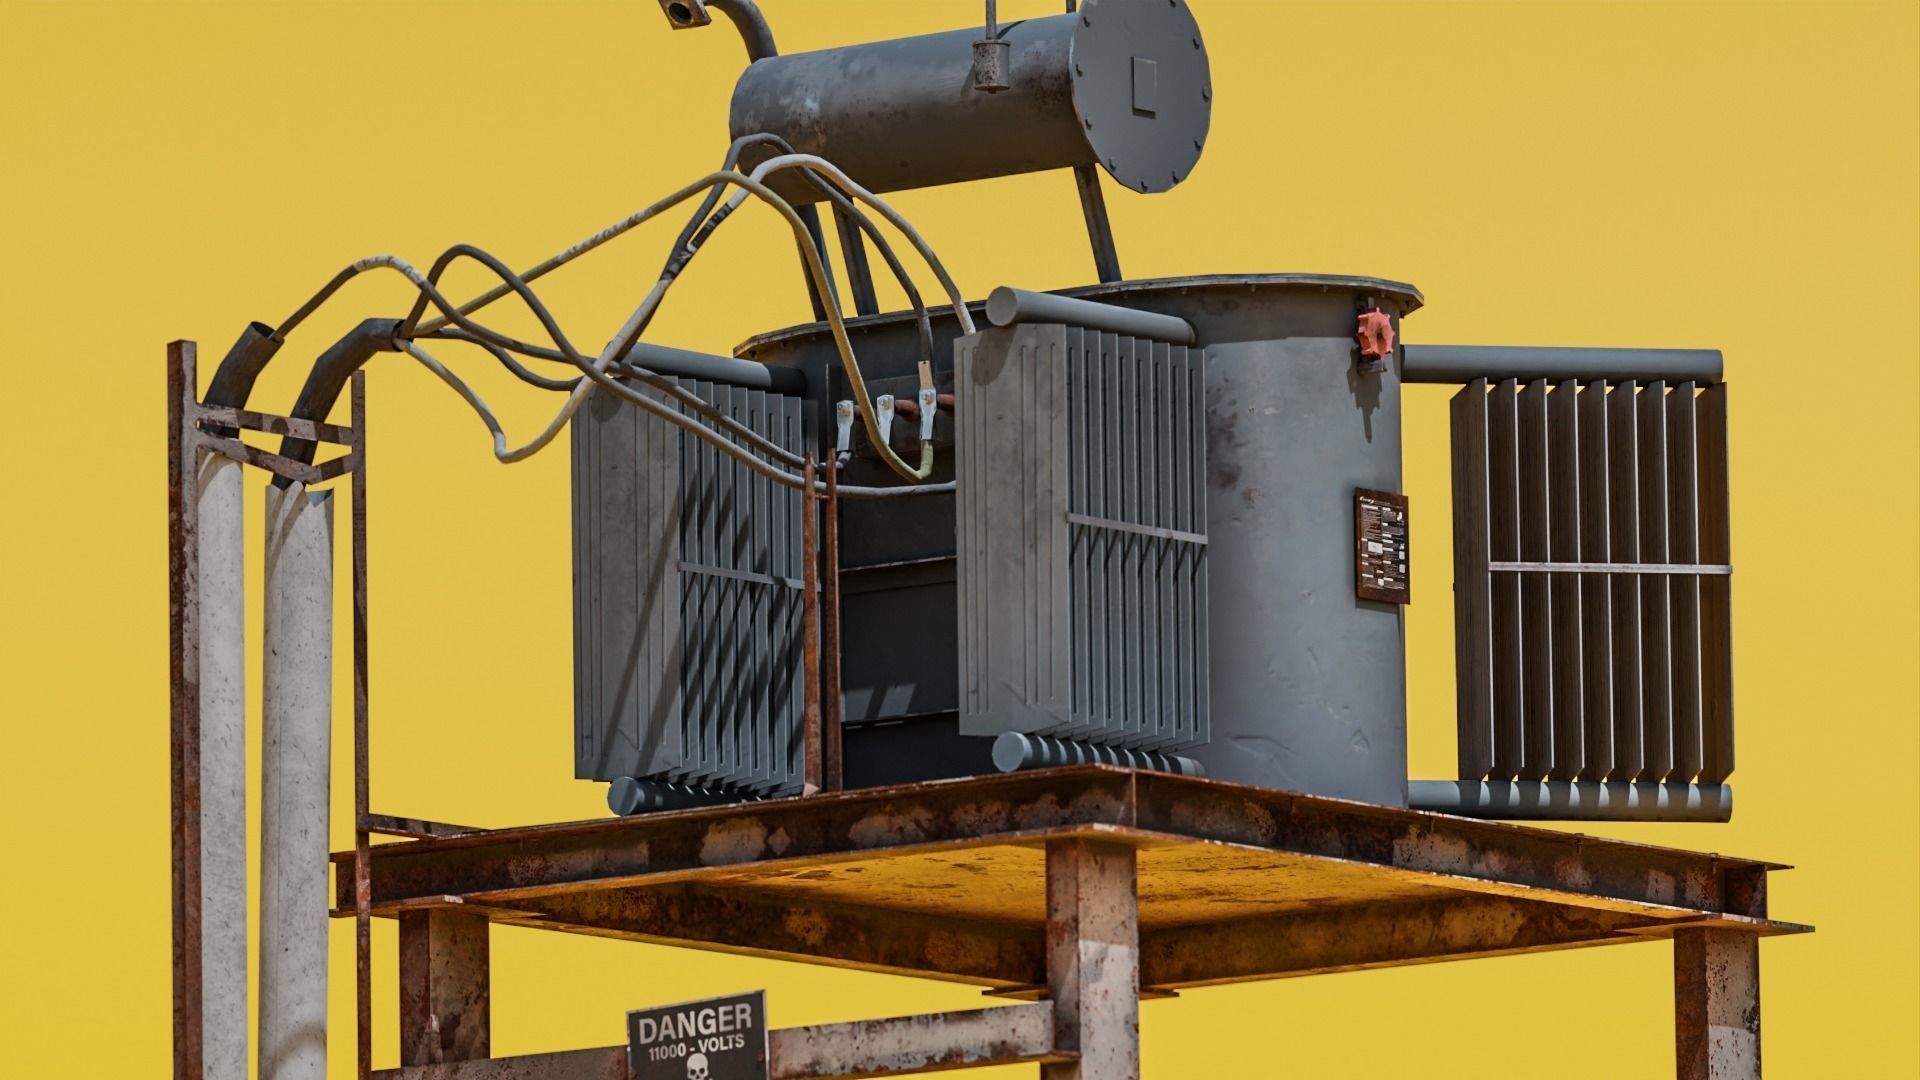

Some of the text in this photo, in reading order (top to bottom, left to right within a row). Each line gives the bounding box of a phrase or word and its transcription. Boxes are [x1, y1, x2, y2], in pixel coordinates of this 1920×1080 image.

[640, 1003, 752, 1044] DANGER
[649, 1042, 686, 1060] 11000
[698, 1033, 745, 1053] VOLTS
